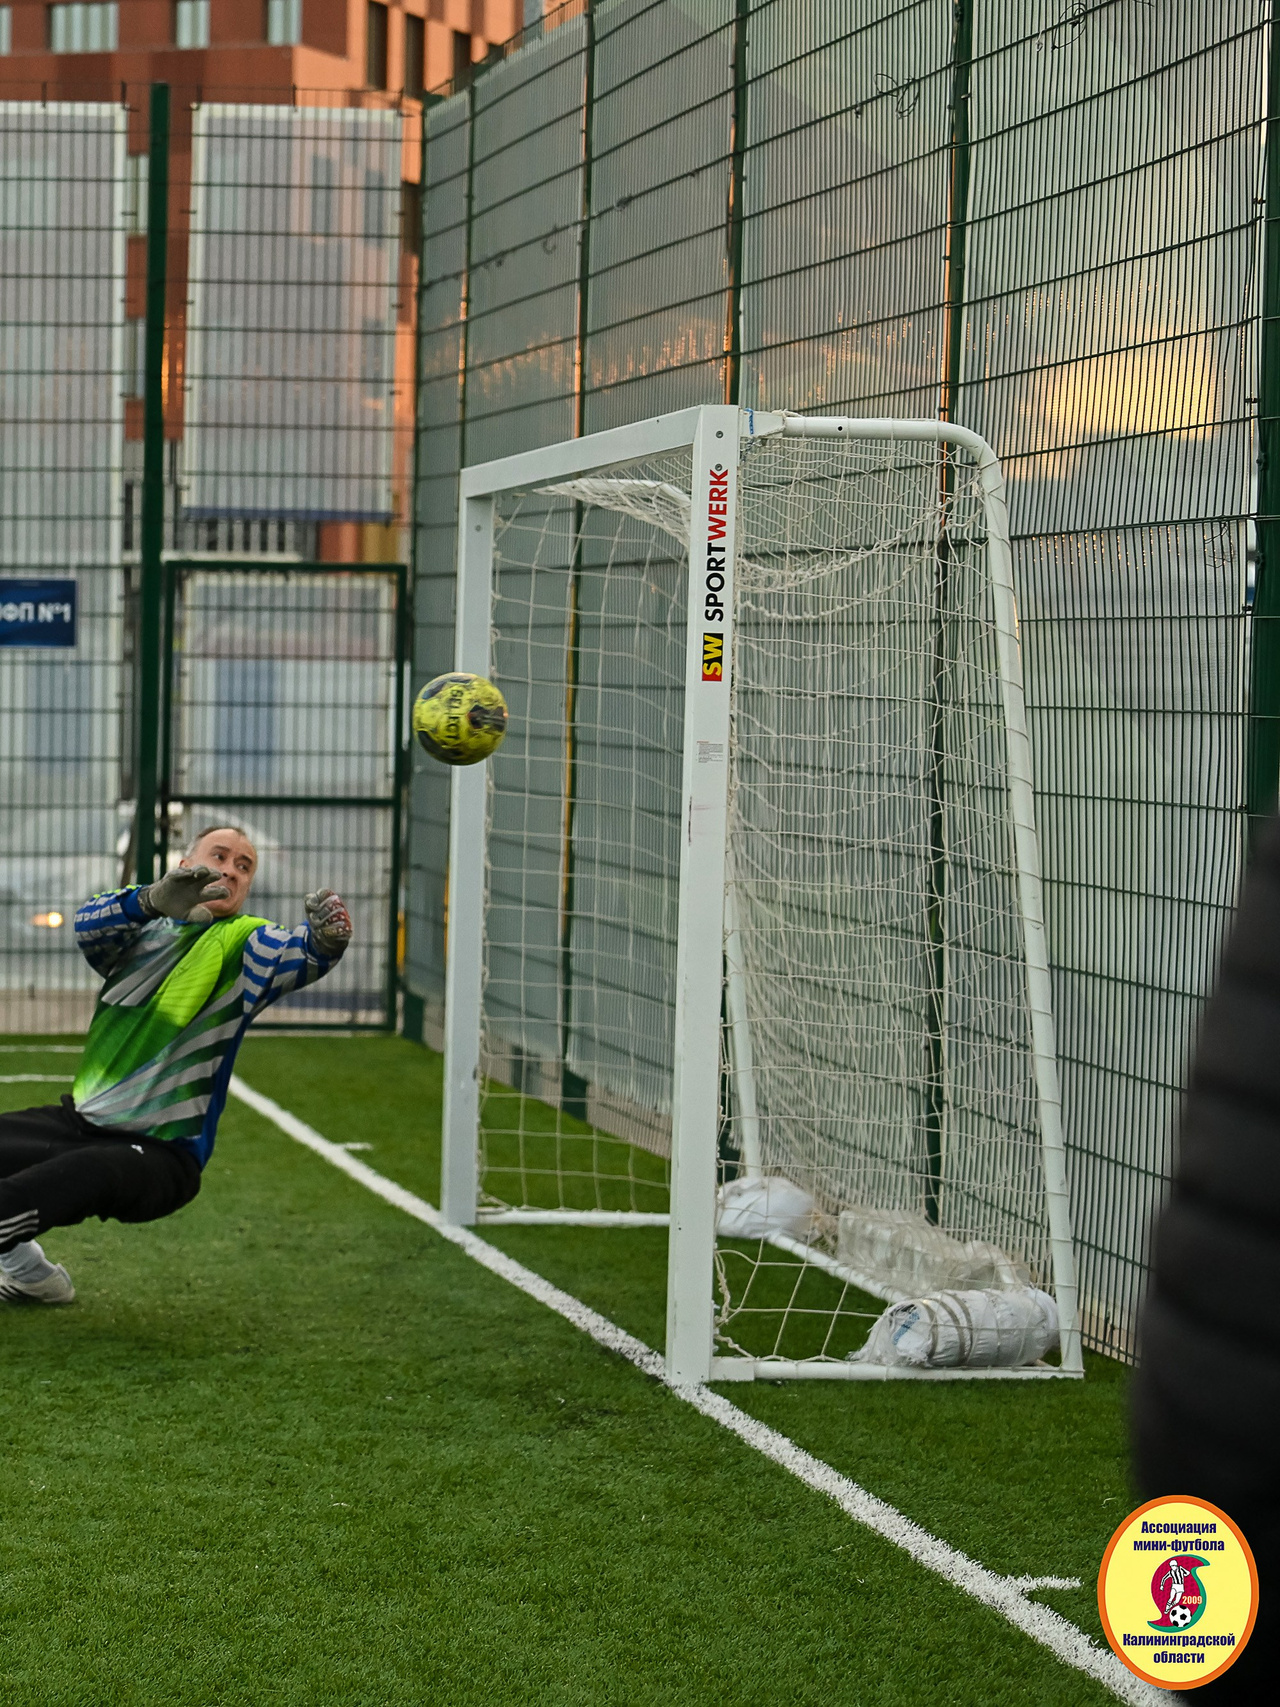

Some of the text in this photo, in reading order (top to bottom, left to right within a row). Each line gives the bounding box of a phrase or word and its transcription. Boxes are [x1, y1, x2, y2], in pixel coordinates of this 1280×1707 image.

[702, 468, 728, 677] SW SPORTWERK
[445, 688, 463, 740] SELECT
